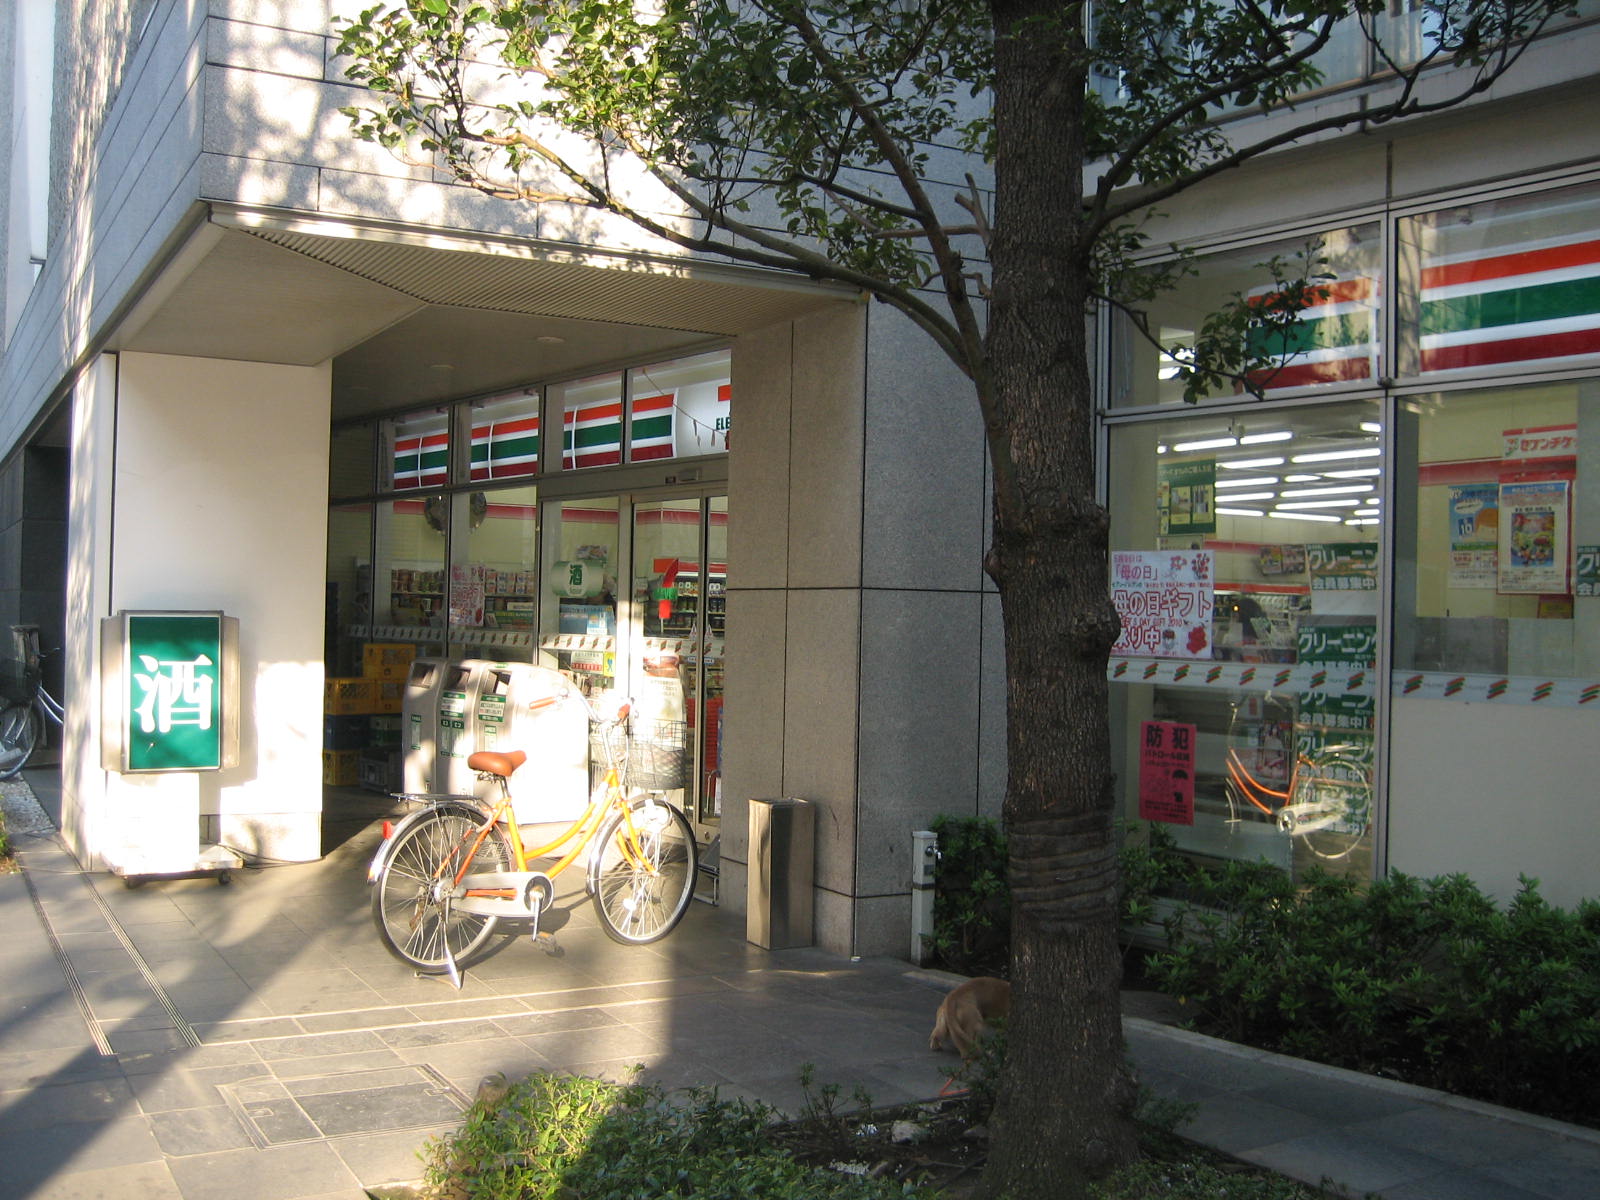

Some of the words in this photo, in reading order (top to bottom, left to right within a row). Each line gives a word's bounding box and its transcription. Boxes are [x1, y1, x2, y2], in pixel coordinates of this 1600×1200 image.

[1520, 436, 1580, 453] セブンチケ
[569, 564, 583, 586] 酒
[1114, 588, 1212, 618] 母の日ギフト
[133, 654, 214, 733] 酒
[1147, 725, 1189, 750] 防犯
